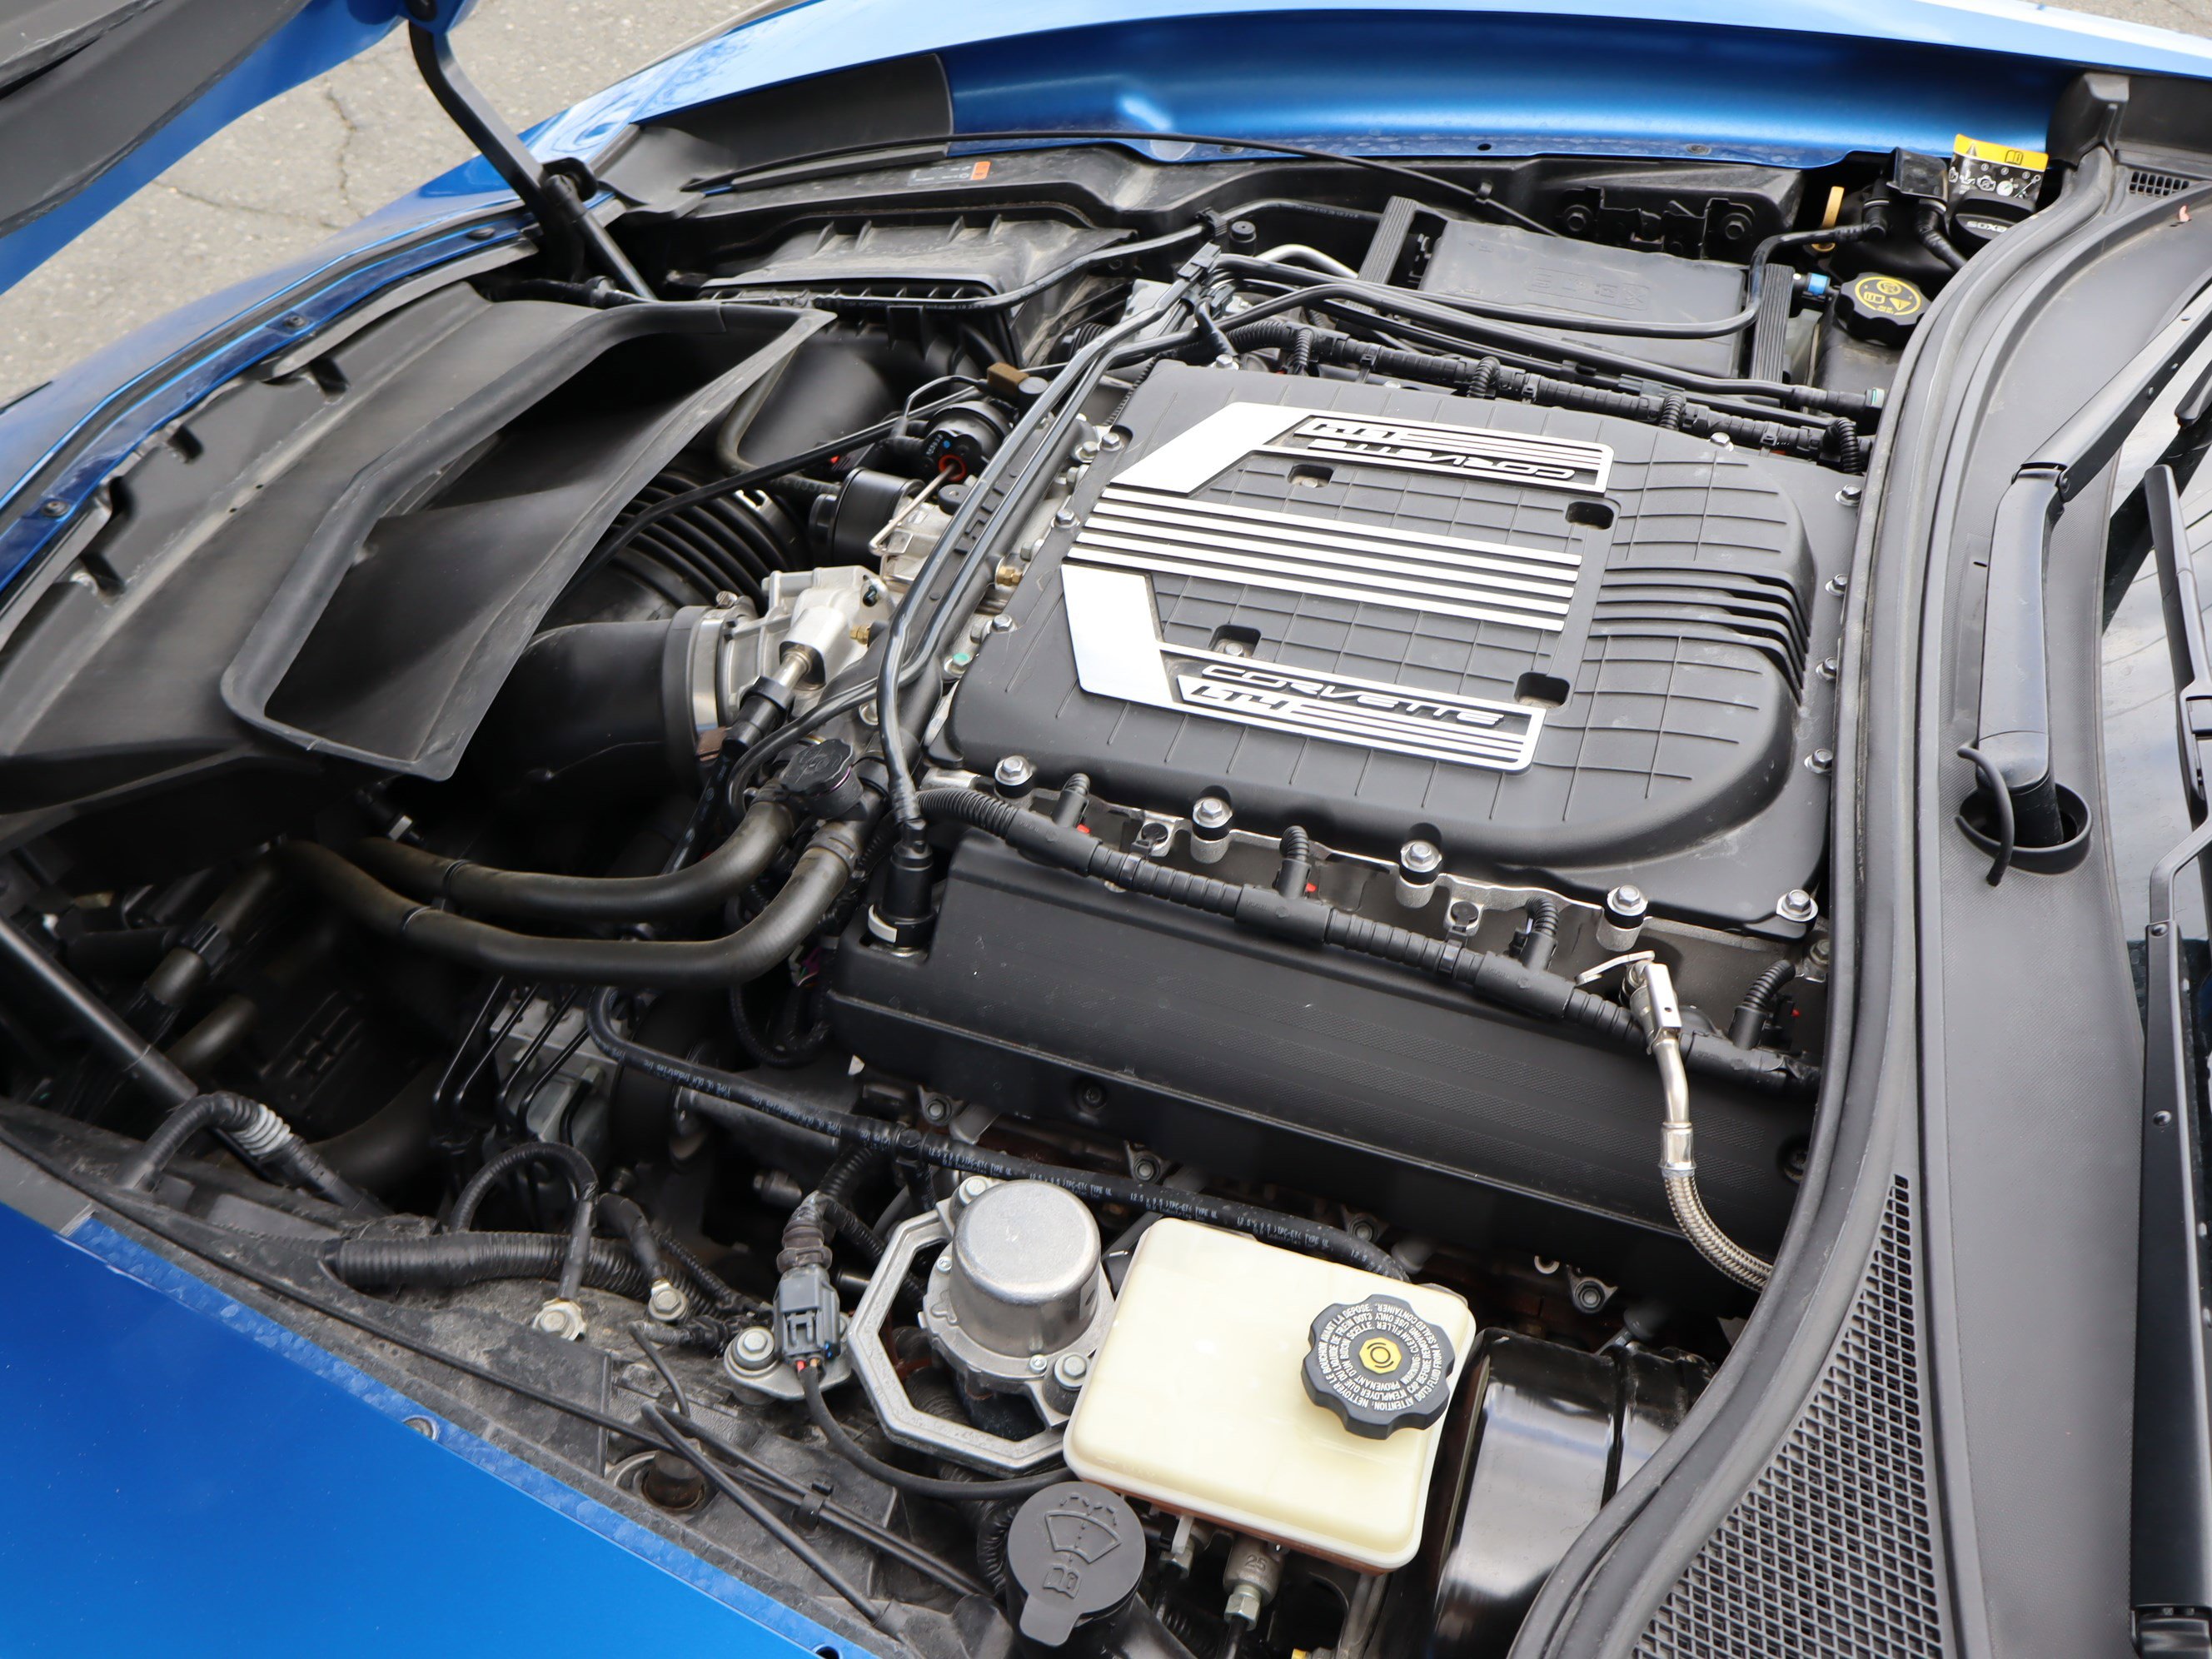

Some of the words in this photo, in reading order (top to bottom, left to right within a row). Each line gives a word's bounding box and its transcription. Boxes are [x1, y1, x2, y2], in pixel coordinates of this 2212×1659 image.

[1966, 221, 2008, 233] exos
[1313, 423, 1401, 441] LT4
[1308, 438, 1576, 481] CORVETTE
[1189, 684, 1292, 712] LT4
[1201, 664, 1505, 728] CORVETTE
[990, 1163, 1004, 1174] TYPE
[1089, 1183, 1104, 1195] TYPE
[1105, 1187, 1113, 1197] UL
[1195, 1206, 1209, 1218] TYPE
[1210, 1209, 1218, 1219] UL
[1305, 1233, 1320, 1246] TYPE
[1333, 1314, 1346, 1325] LA
[1342, 1303, 1373, 1319] DEPOSE.
[1353, 1313, 1373, 1324] DOT3
[1374, 1303, 1418, 1324] CONTAINER.
[1374, 1312, 1394, 1323] ONLY
[1320, 1321, 1338, 1343] AVANT
[1334, 1318, 1355, 1337] FREIN
[1346, 1321, 1375, 1340] SCELLE.
[1376, 1321, 1403, 1337] FILLER
[1394, 1316, 1410, 1330] USE
[1330, 1334, 1342, 1345] DE
[1408, 1324, 1432, 1359] REMOVING.
[1416, 1321, 1437, 1345] SEALED
[1339, 1338, 1352, 1360] BIDON
[1399, 1332, 1419, 1353] CLEAN
[1318, 1341, 1332, 1374] BOUCHON
[1328, 1344, 1342, 1372] LIQUIDE
[1432, 1349, 1442, 1369] FROM
[1336, 1370, 1348, 1382] DU
[1342, 1360, 1357, 1378] D'UN
[1400, 1353, 1421, 1385] WARNING:
[1416, 1359, 1432, 1385] BEFORE
[1326, 1373, 1338, 1384] LE
[1344, 1378, 1362, 1393] QUE
[1353, 1374, 1401, 1392] PROVENANT
[1407, 1381, 1420, 1394] CAP
[1427, 1368, 1442, 1389] FLUID
[1333, 1381, 1369, 1408] NETTOYER
[1360, 1387, 1407, 1402] N'EMPLOYER
[1414, 1385, 1432, 1402] DOT3
[1244, 1553, 1268, 1573] 25
